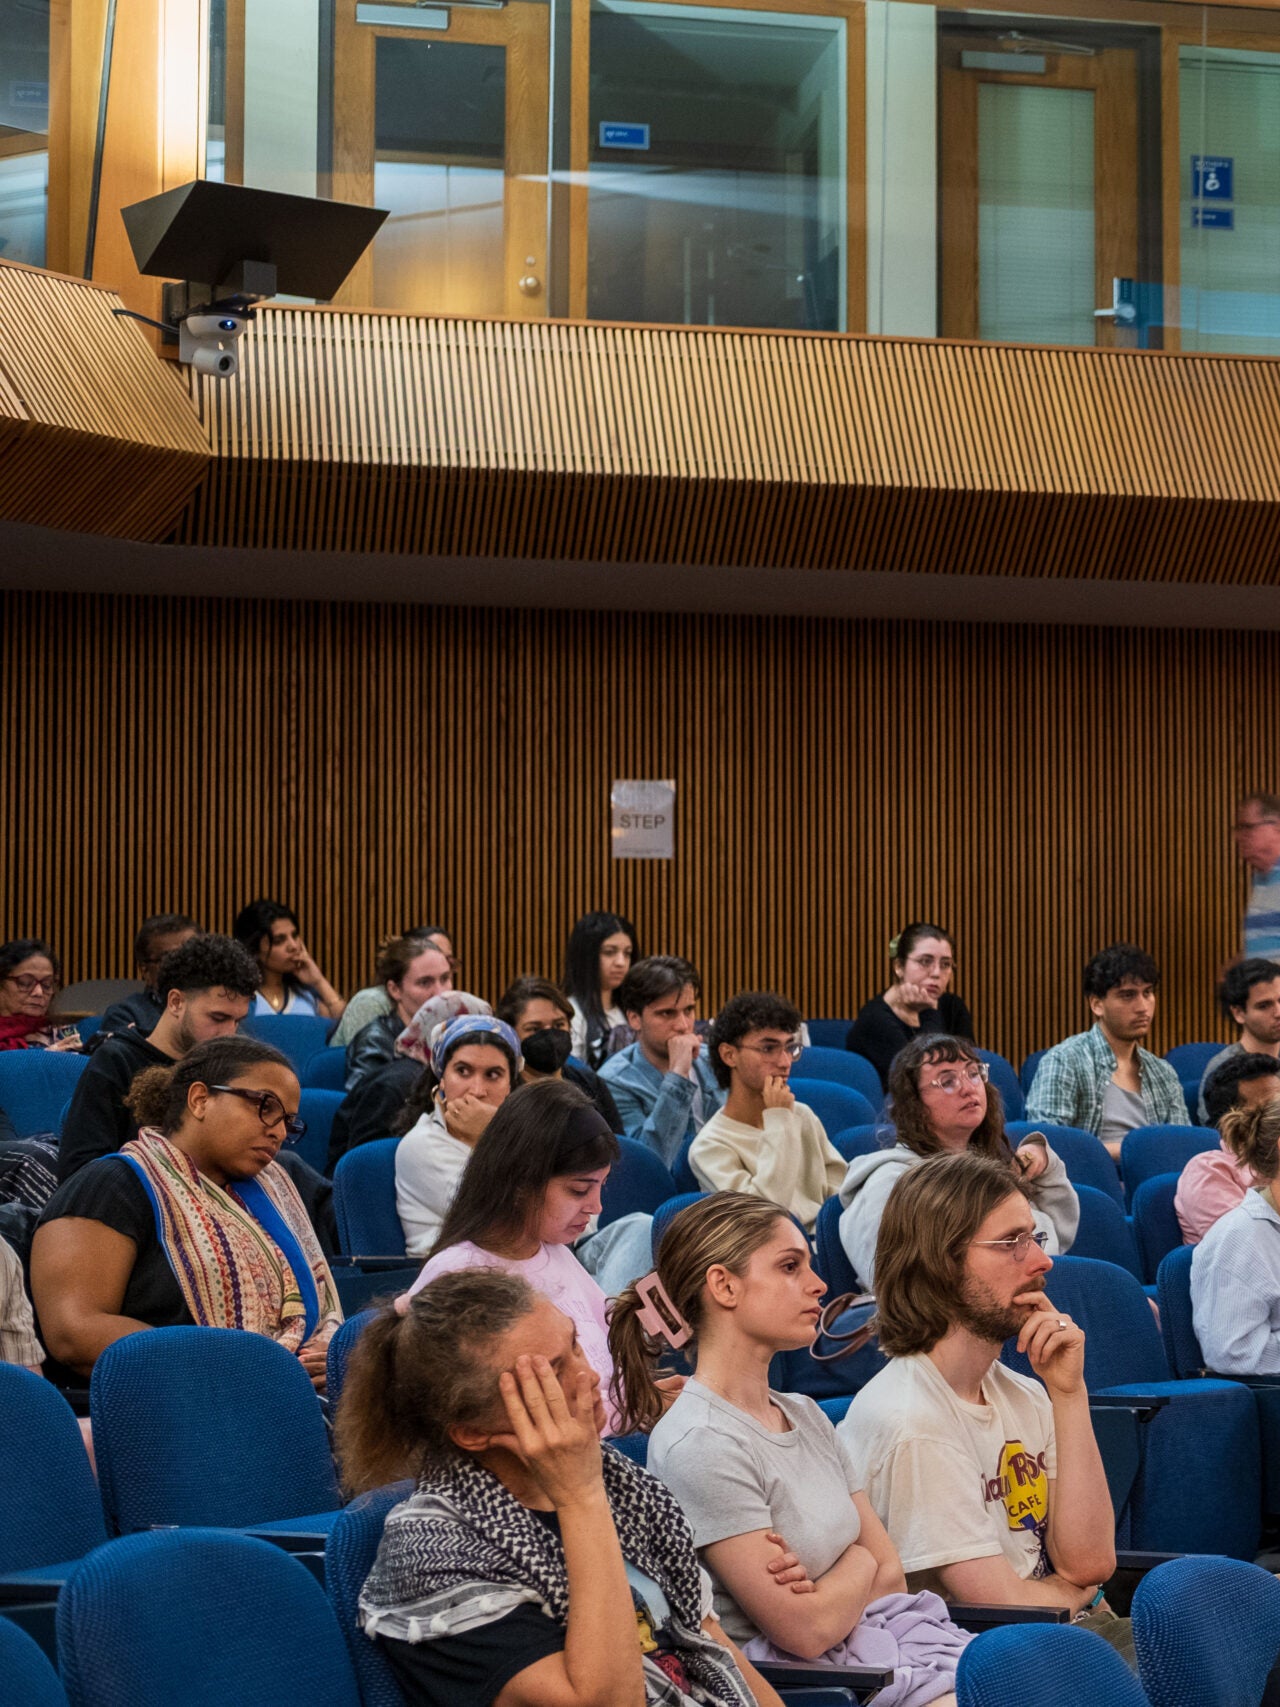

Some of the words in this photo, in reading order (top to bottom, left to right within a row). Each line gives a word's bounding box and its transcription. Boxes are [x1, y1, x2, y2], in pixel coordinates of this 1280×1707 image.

[620, 813, 665, 829] STEP
[1008, 1451, 1047, 1487] Roc
[1008, 1494, 1042, 1517] CAFE
